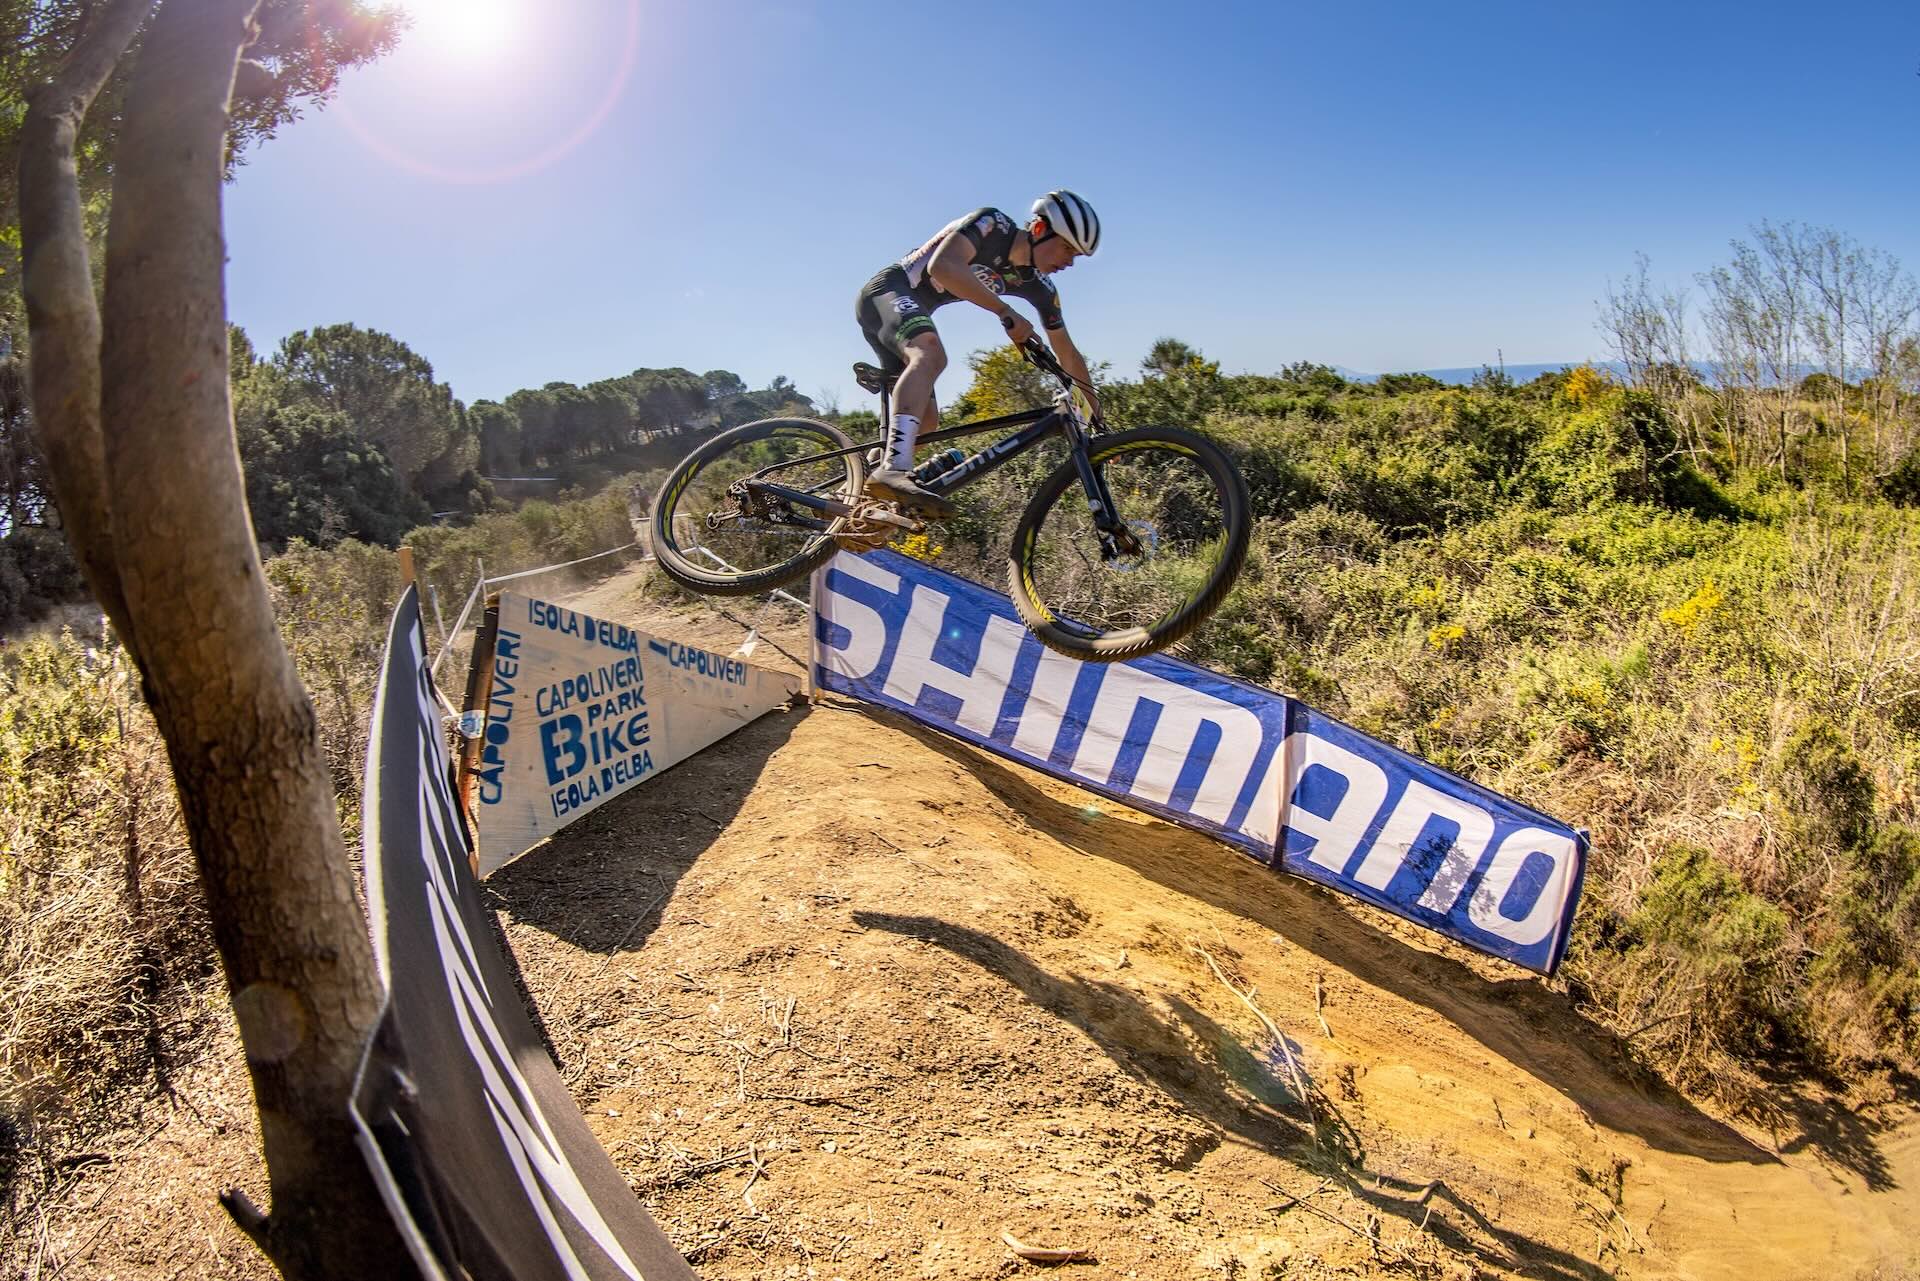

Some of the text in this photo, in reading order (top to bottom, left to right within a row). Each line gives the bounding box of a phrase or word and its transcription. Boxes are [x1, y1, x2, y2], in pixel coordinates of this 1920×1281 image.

[529, 598, 579, 637] ISOLA
[584, 615, 640, 653] D'ELBA
[480, 629, 521, 804] CAPOLIVERI
[536, 655, 643, 717] CAPOLIVERI
[588, 685, 647, 726] PARK
[539, 711, 650, 786] BIKE
[815, 550, 1579, 946] SHIMANO
[551, 750, 654, 817] ISOLA D'ELBA
